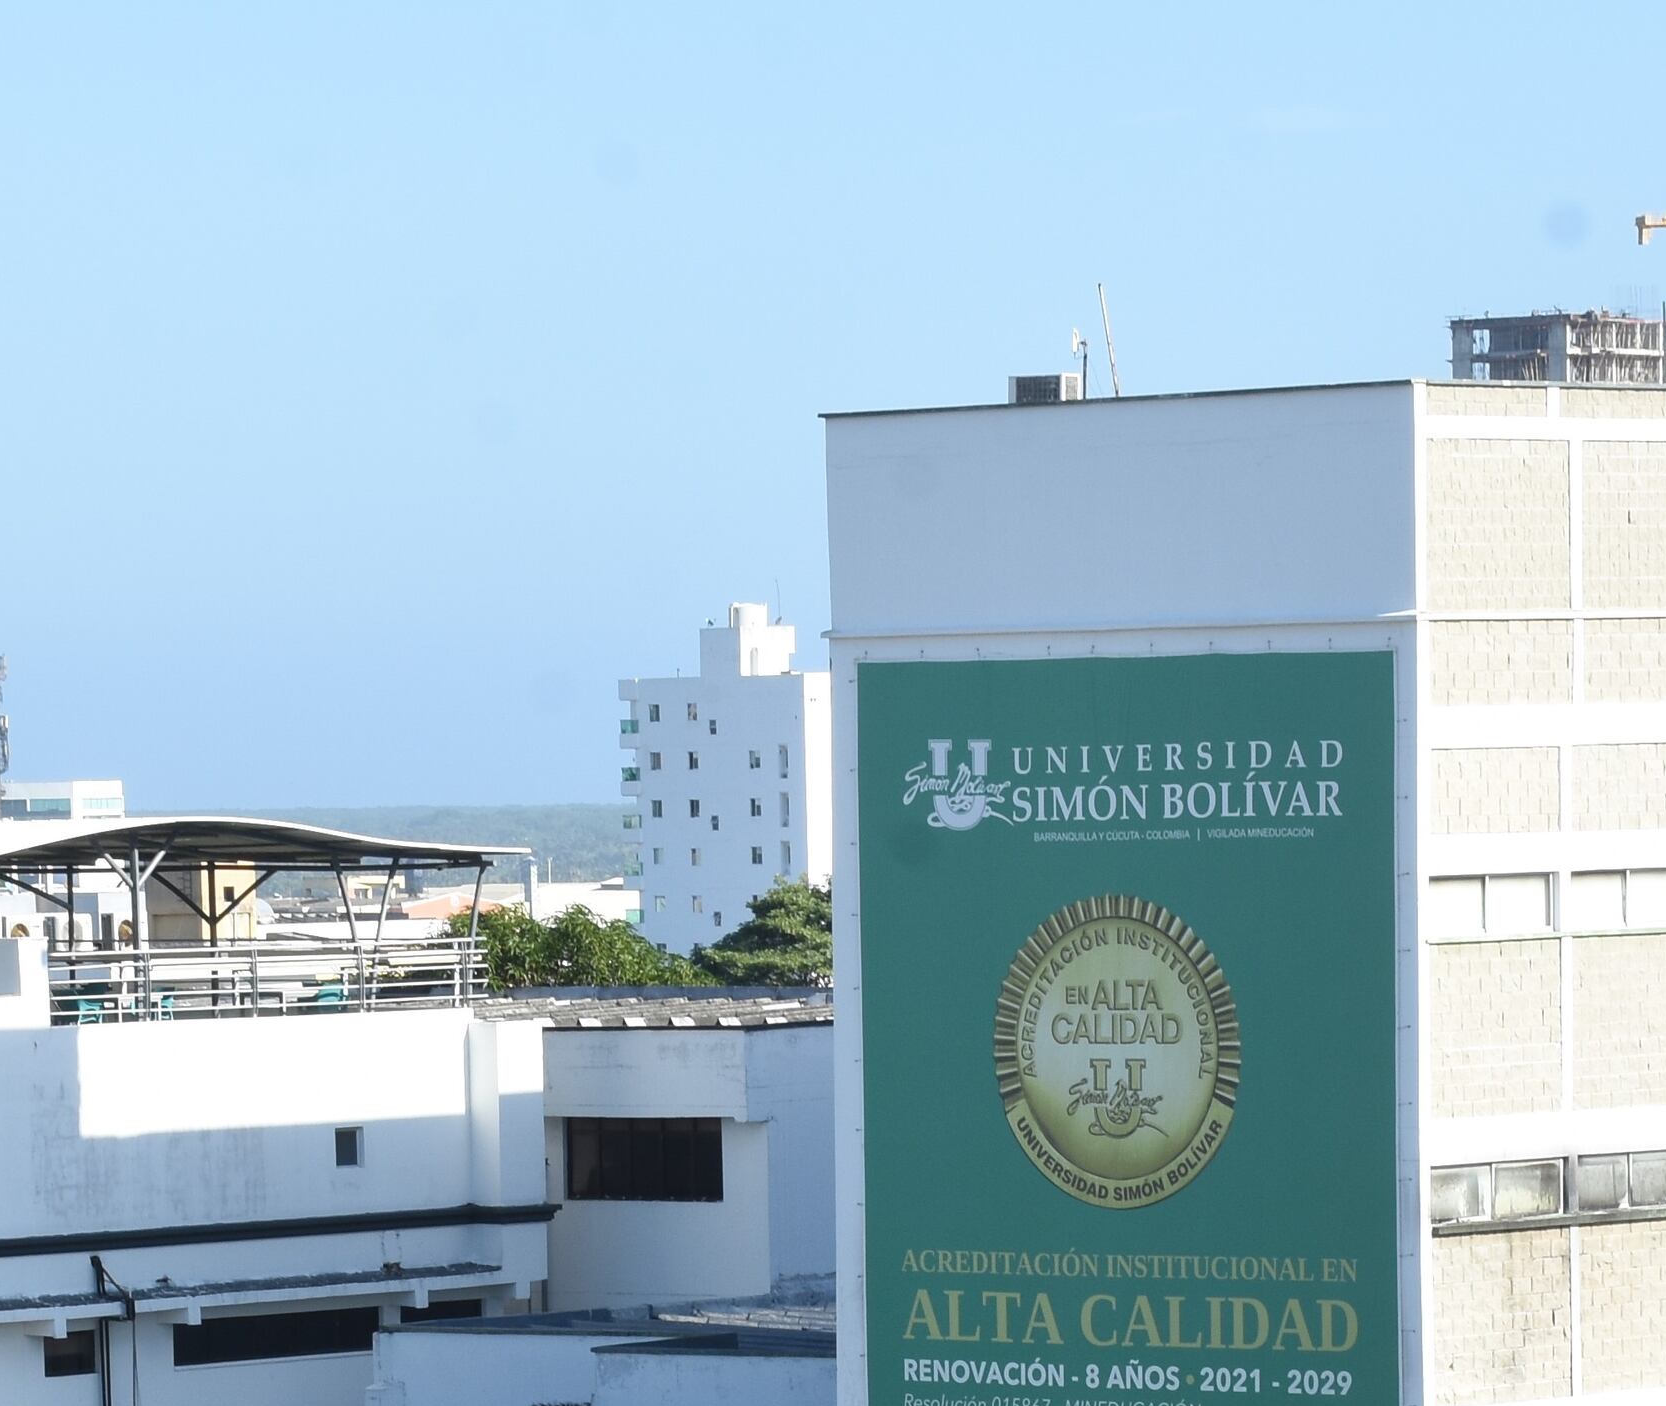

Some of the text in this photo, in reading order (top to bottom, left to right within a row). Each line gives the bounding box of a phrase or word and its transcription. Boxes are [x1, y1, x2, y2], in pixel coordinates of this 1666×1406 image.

[1013, 739, 1344, 775] UNIVERSIDAD
[1012, 773, 1344, 823] SIMÓN BOLÍVAR
[1033, 832, 1097, 842] BARRANQUILLA
[1098, 831, 1104, 841] Y
[1106, 828, 1139, 841] CÚCUTA
[1146, 830, 1190, 840] COLOMBIA
[1207, 828, 1246, 839] VIGILADA
[1247, 826, 1315, 838] MINEDUCACIÓN
[1020, 926, 1215, 1079] ACREDITACIÓN INSTITUCIONAL
[1065, 979, 1164, 1011] EN ALTA
[1051, 1012, 1183, 1045] CALIDAD
[1016, 1116, 1223, 1201] UNIVERSIDAD SIMÓN BOLÍVAR
[901, 1247, 1357, 1282] ACREDITACIÓN INSTITUCIONAL EN
[902, 1288, 1359, 1352] ALTA CALIDAD
[903, 1357, 1065, 1387] RENOVACIÓN
[1085, 1364, 1101, 1389] 8
[1106, 1359, 1181, 1391] AÑOS
[1199, 1367, 1261, 1393] 2021
[1287, 1369, 1353, 1395] 2029
